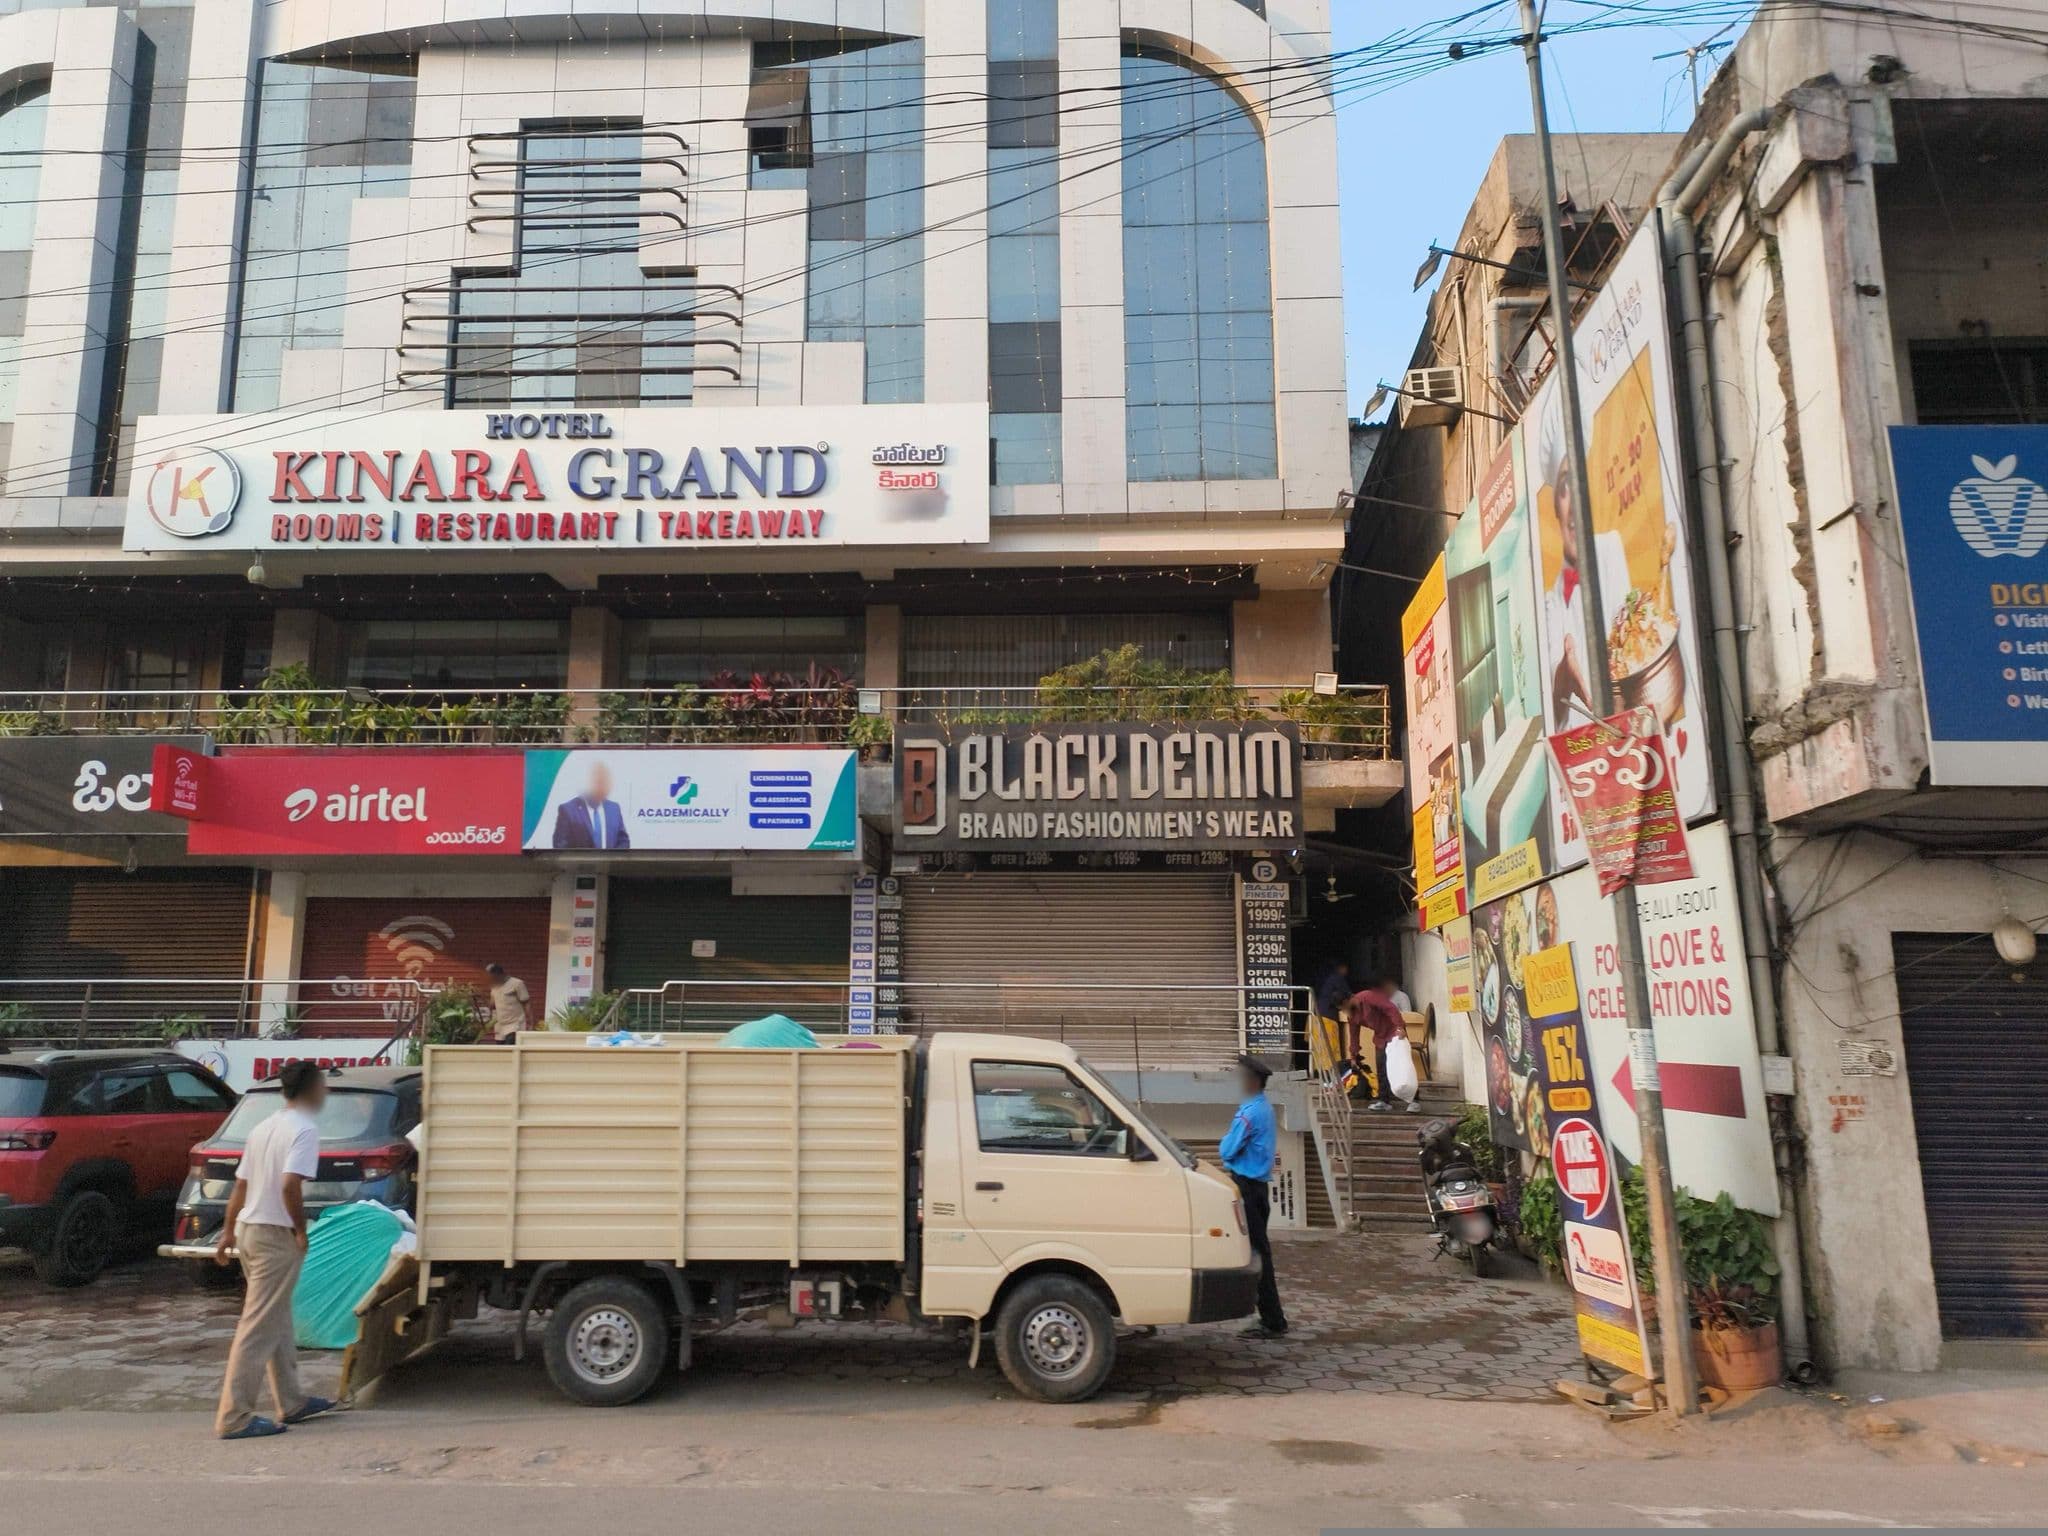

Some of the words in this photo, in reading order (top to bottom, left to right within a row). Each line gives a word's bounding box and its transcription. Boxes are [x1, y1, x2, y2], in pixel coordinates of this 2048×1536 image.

[485, 413, 613, 438] HOTEL
[872, 442, 945, 463] హోటల్
[269, 448, 546, 503] KINARA
[567, 446, 828, 501] GRAND
[272, 513, 385, 543] ROOMS
[415, 511, 619, 542] RESTAURANT
[658, 508, 826, 540] TAKEAWAY
[959, 732, 1119, 801] BLACK
[1129, 731, 1293, 800] DENIM
[323, 784, 428, 822] airtel
[637, 808, 730, 818] ACADEMICALLY
[958, 812, 1038, 840] BRAND
[1042, 812, 1141, 839] FASHION
[1144, 811, 1218, 840] MEN'S
[1223, 810, 1295, 838] WEAR
[1245, 891, 1286, 899] FINSERV
[1654, 897, 1674, 920] ALL
[1677, 886, 1717, 915] ABOUT
[1247, 908, 1286, 921] 1999/-
[1246, 934, 1286, 942] OFFER
[1247, 943, 1287, 956] 2399/-
[1649, 928, 1706, 970] LOVE
[1710, 924, 1727, 964] &
[1247, 969, 1287, 977] OFFER
[1256, 992, 1289, 1000] SHIRTS
[1587, 976, 1732, 1020] CELEATIONS
[1248, 1014, 1289, 1028] 2399/-
[1542, 1025, 1586, 1083] 15%
[1559, 1129, 1598, 1165] TAKE
